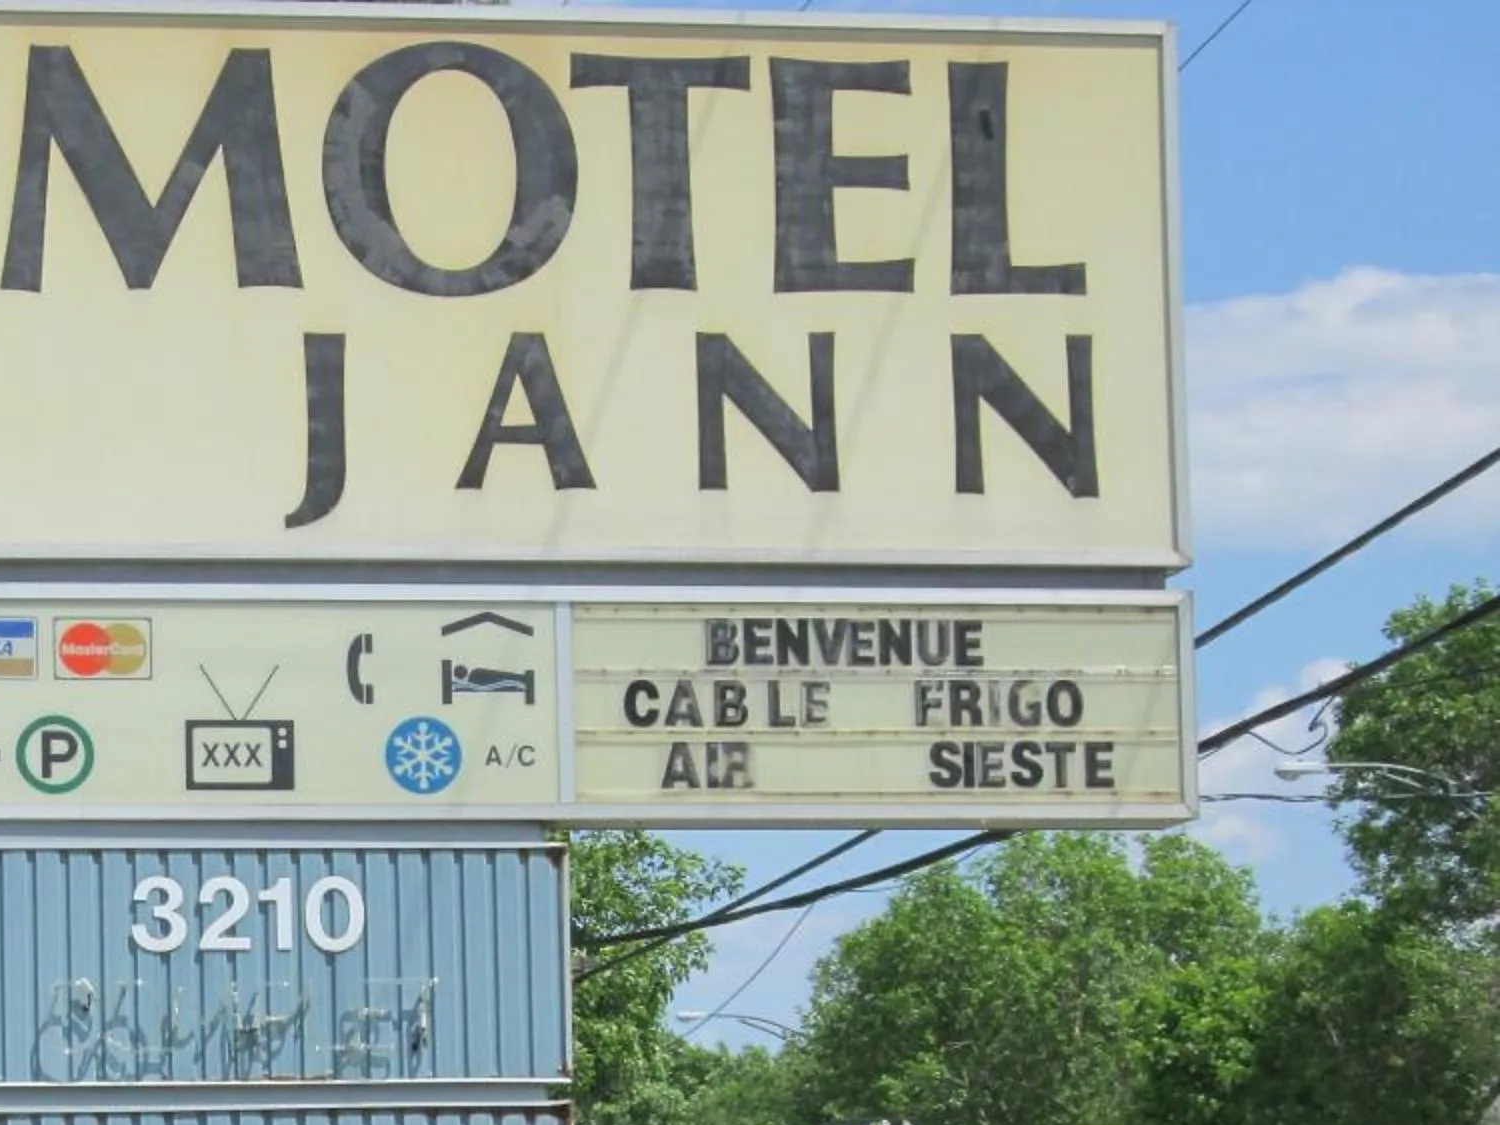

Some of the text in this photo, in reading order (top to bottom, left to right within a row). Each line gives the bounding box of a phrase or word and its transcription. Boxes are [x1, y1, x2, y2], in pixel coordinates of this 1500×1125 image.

[0, 41, 1088, 297] MOTEL
[285, 331, 1100, 528] JANN
[61, 643, 145, 656] MasterCard
[623, 679, 1085, 728] CABLE FRIGO
[41, 731, 79, 779] P
[201, 743, 264, 768] XXX
[484, 744, 536, 769] A/C
[661, 741, 1116, 788] AIR SIESTE
[131, 875, 365, 953] 3210
